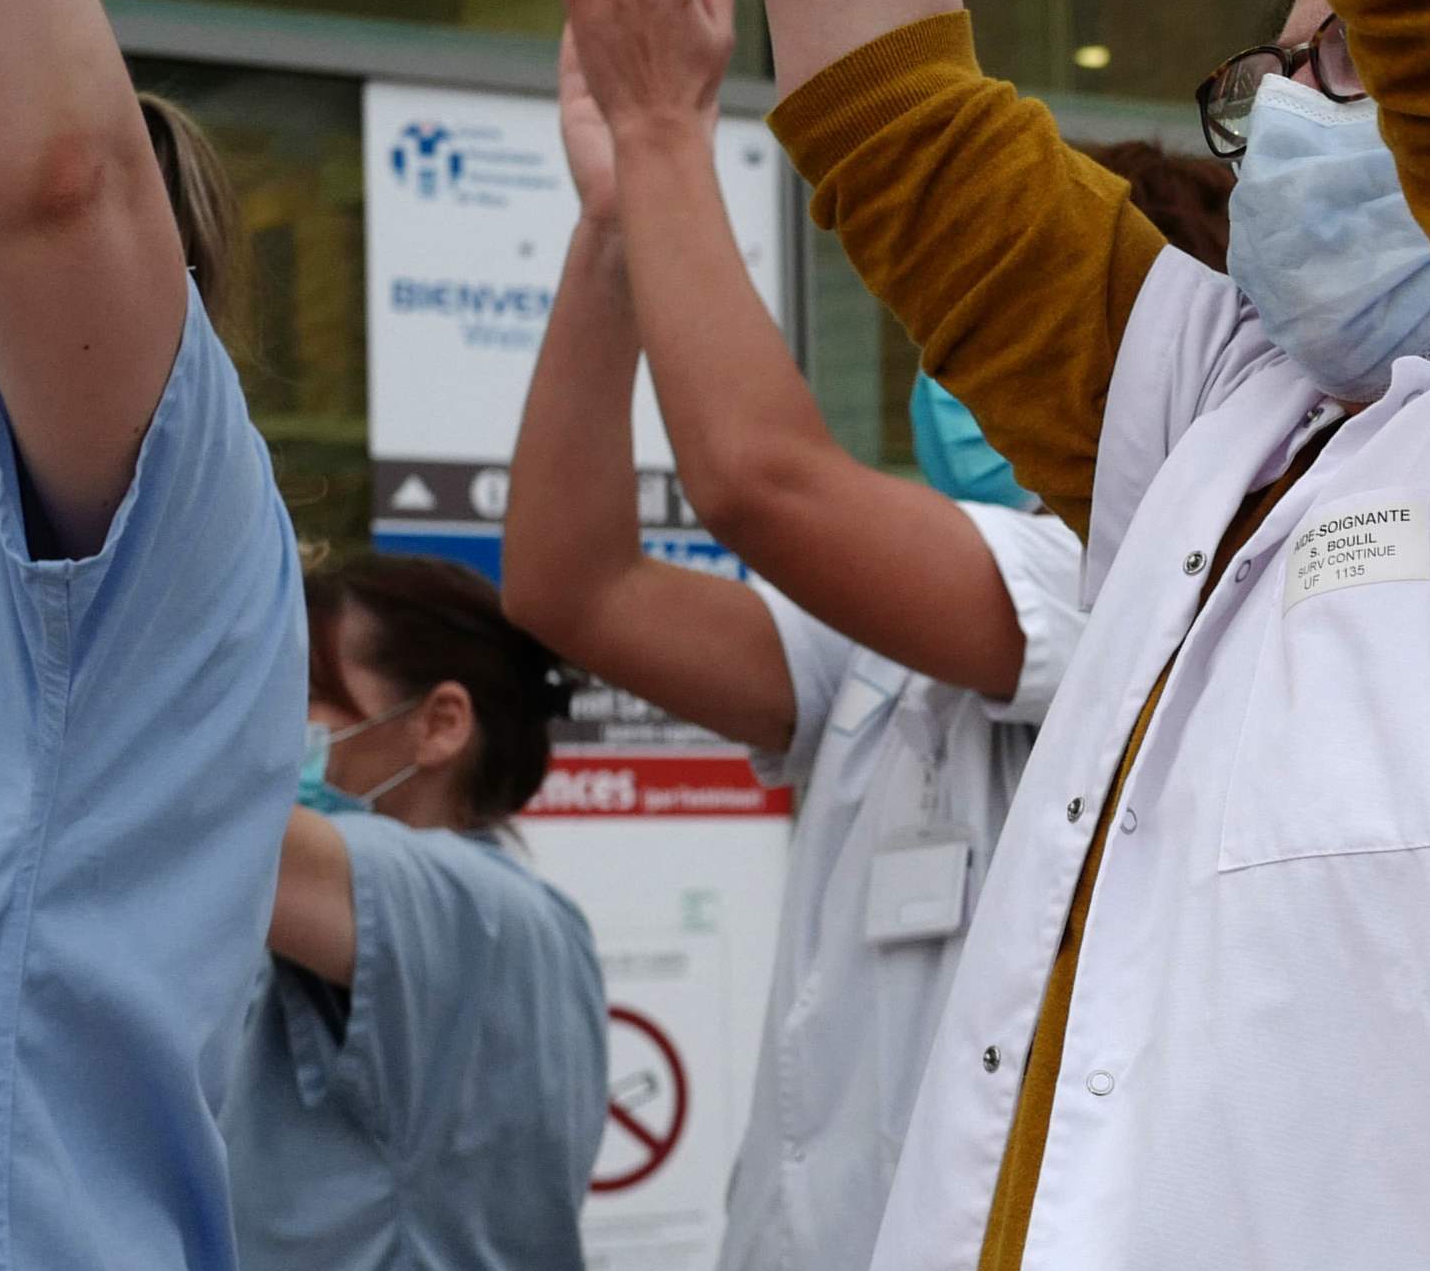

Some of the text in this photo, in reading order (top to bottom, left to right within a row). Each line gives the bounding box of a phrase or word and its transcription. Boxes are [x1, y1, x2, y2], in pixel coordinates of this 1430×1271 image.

[1294, 508, 1411, 554] AIDE-SOIGNANTE
[1327, 532, 1378, 553] BOULIL
[1297, 545, 1397, 579] SURV CONTINUE
[1303, 564, 1366, 591] UF 1135
